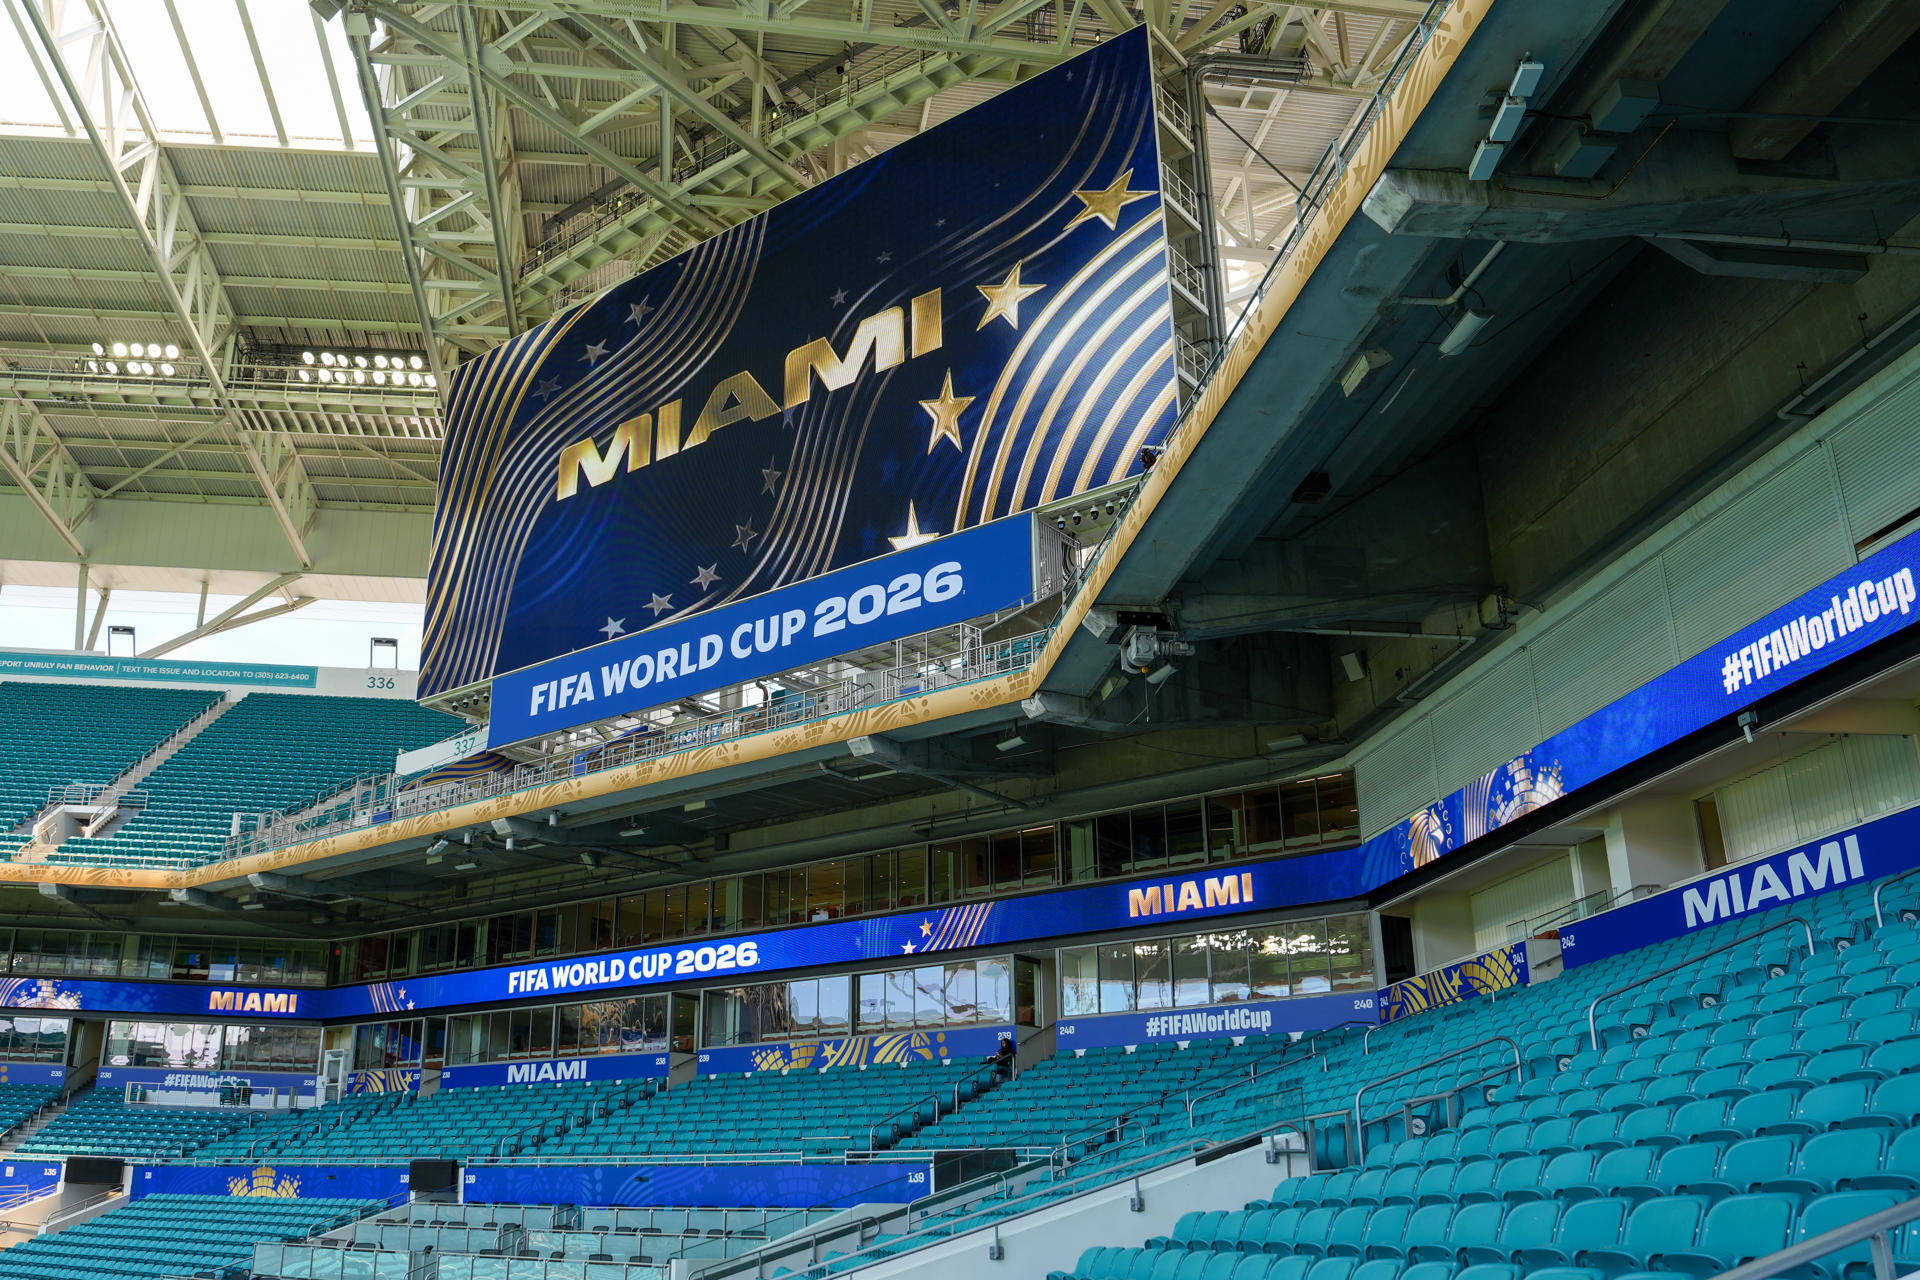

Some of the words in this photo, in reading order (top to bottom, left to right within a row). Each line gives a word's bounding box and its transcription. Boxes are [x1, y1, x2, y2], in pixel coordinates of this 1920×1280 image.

[556, 287, 942, 501] MIAMI
[529, 671, 594, 716] FIFA
[600, 633, 723, 697] WORLD
[730, 609, 805, 660] CUP
[813, 561, 964, 637] 2026
[1722, 567, 1916, 695] #FIFAWorldCup
[24, 661, 55, 669] UNRULY
[74, 664, 114, 672] BEHAVIOR
[122, 665, 141, 673] TEXT
[143, 666, 158, 674] THE
[159, 667, 180, 675] ISSUE
[182, 668, 200, 676] AND
[201, 669, 241, 678] LOCATION
[254, 671, 274, 680] (305)
[275, 672, 310, 681] 623-6400
[367, 676, 395, 690] 336
[453, 737, 476, 756] 337
[1682, 833, 1865, 929] MIAMI
[1128, 872, 1254, 918] MIAMI
[1561, 934, 1576, 950] 242
[508, 968, 549, 994] FIFA
[551, 959, 626, 987] WORLD
[628, 952, 673, 979] CUP
[675, 941, 758, 975] 2026
[1512, 952, 1525, 966] 241
[208, 990, 298, 1013] MIAMI
[1353, 998, 1373, 1010] 240
[1059, 1025, 1075, 1035] 240
[1146, 1008, 1272, 1037] #FIFAWorldCup
[997, 1031, 1012, 1041] 239
[698, 1054, 710, 1063] 239
[507, 1060, 588, 1083] MIAMI
[164, 1073, 251, 1089] #FIFAWorlC
[44, 1168, 57, 1176] 135
[465, 1174, 476, 1184] 139
[908, 1171, 925, 1184] 139
